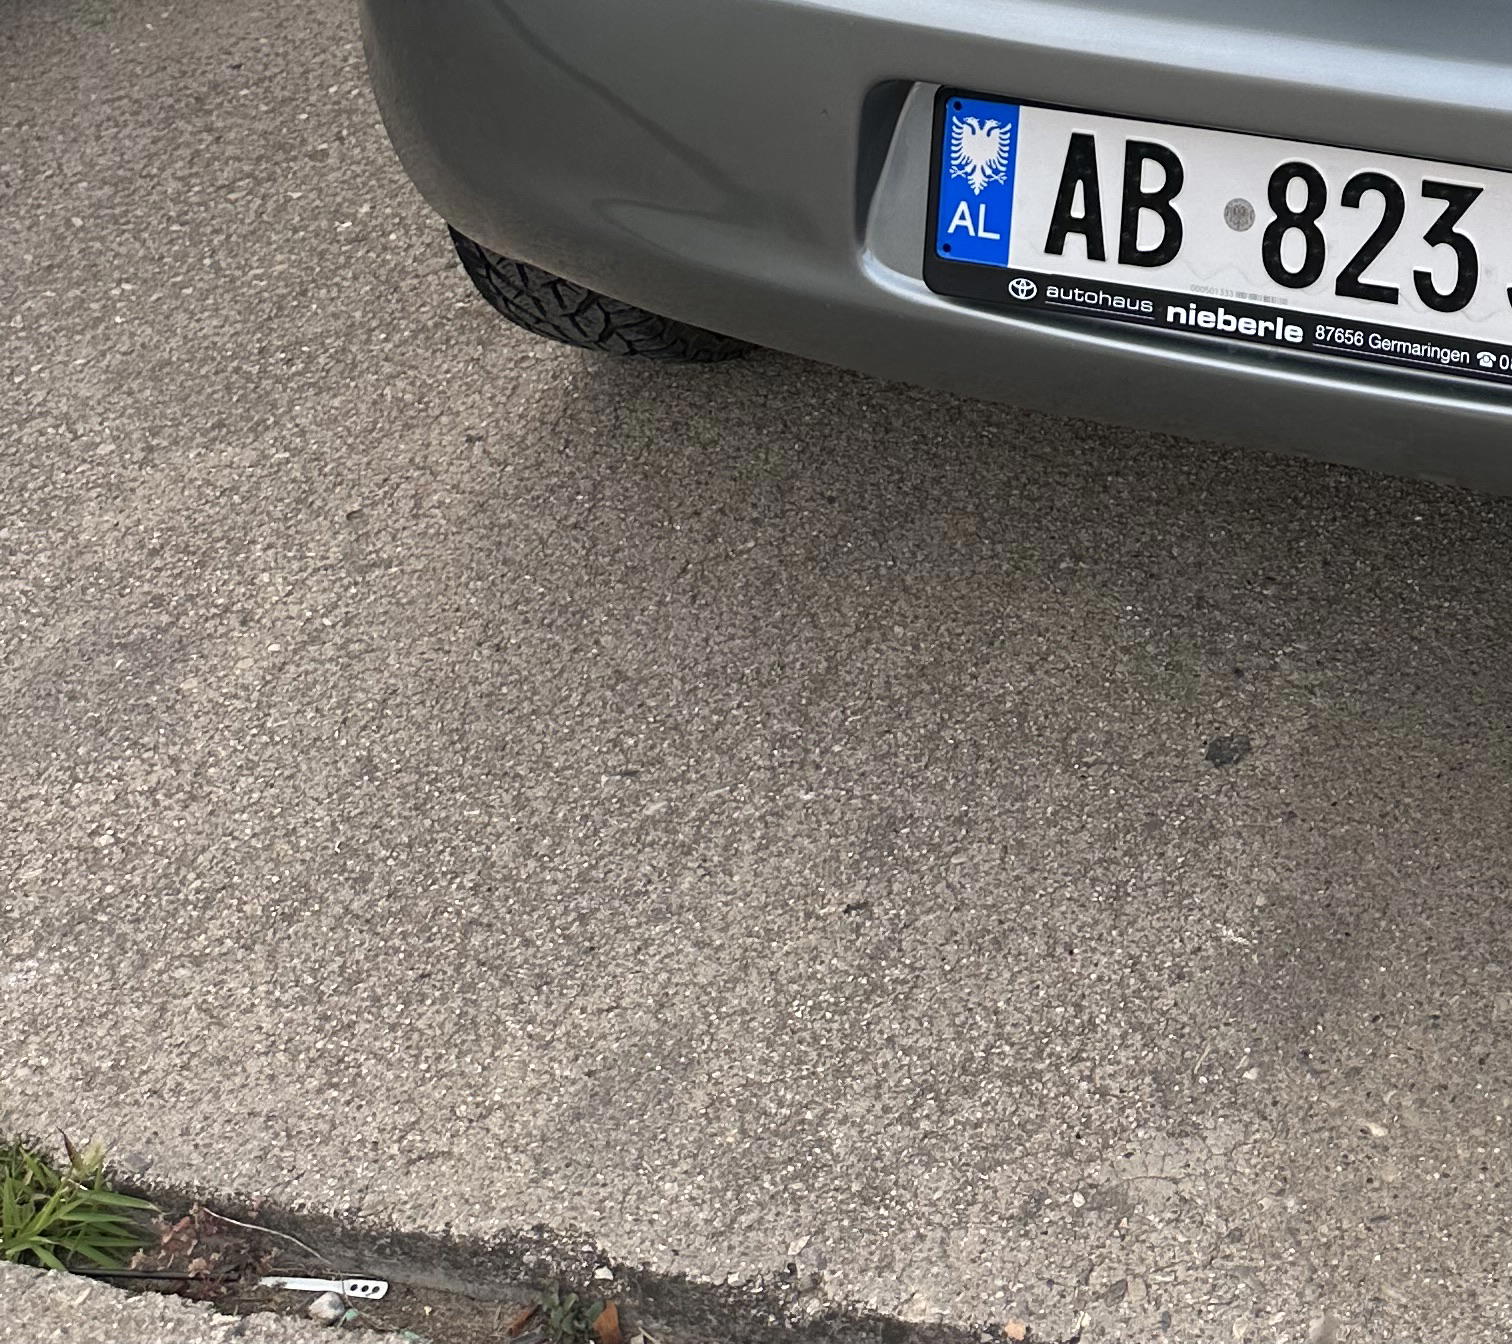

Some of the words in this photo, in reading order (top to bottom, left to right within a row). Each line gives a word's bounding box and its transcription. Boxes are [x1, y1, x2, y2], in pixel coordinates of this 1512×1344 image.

[947, 200, 1001, 241] AL
[1044, 131, 1185, 269] AB
[1261, 160, 1485, 313] 823
[1046, 283, 1154, 313] autohaus
[1166, 302, 1304, 344] nieberle
[1314, 324, 1364, 347] 87656
[1368, 333, 1471, 365] Germaringen
